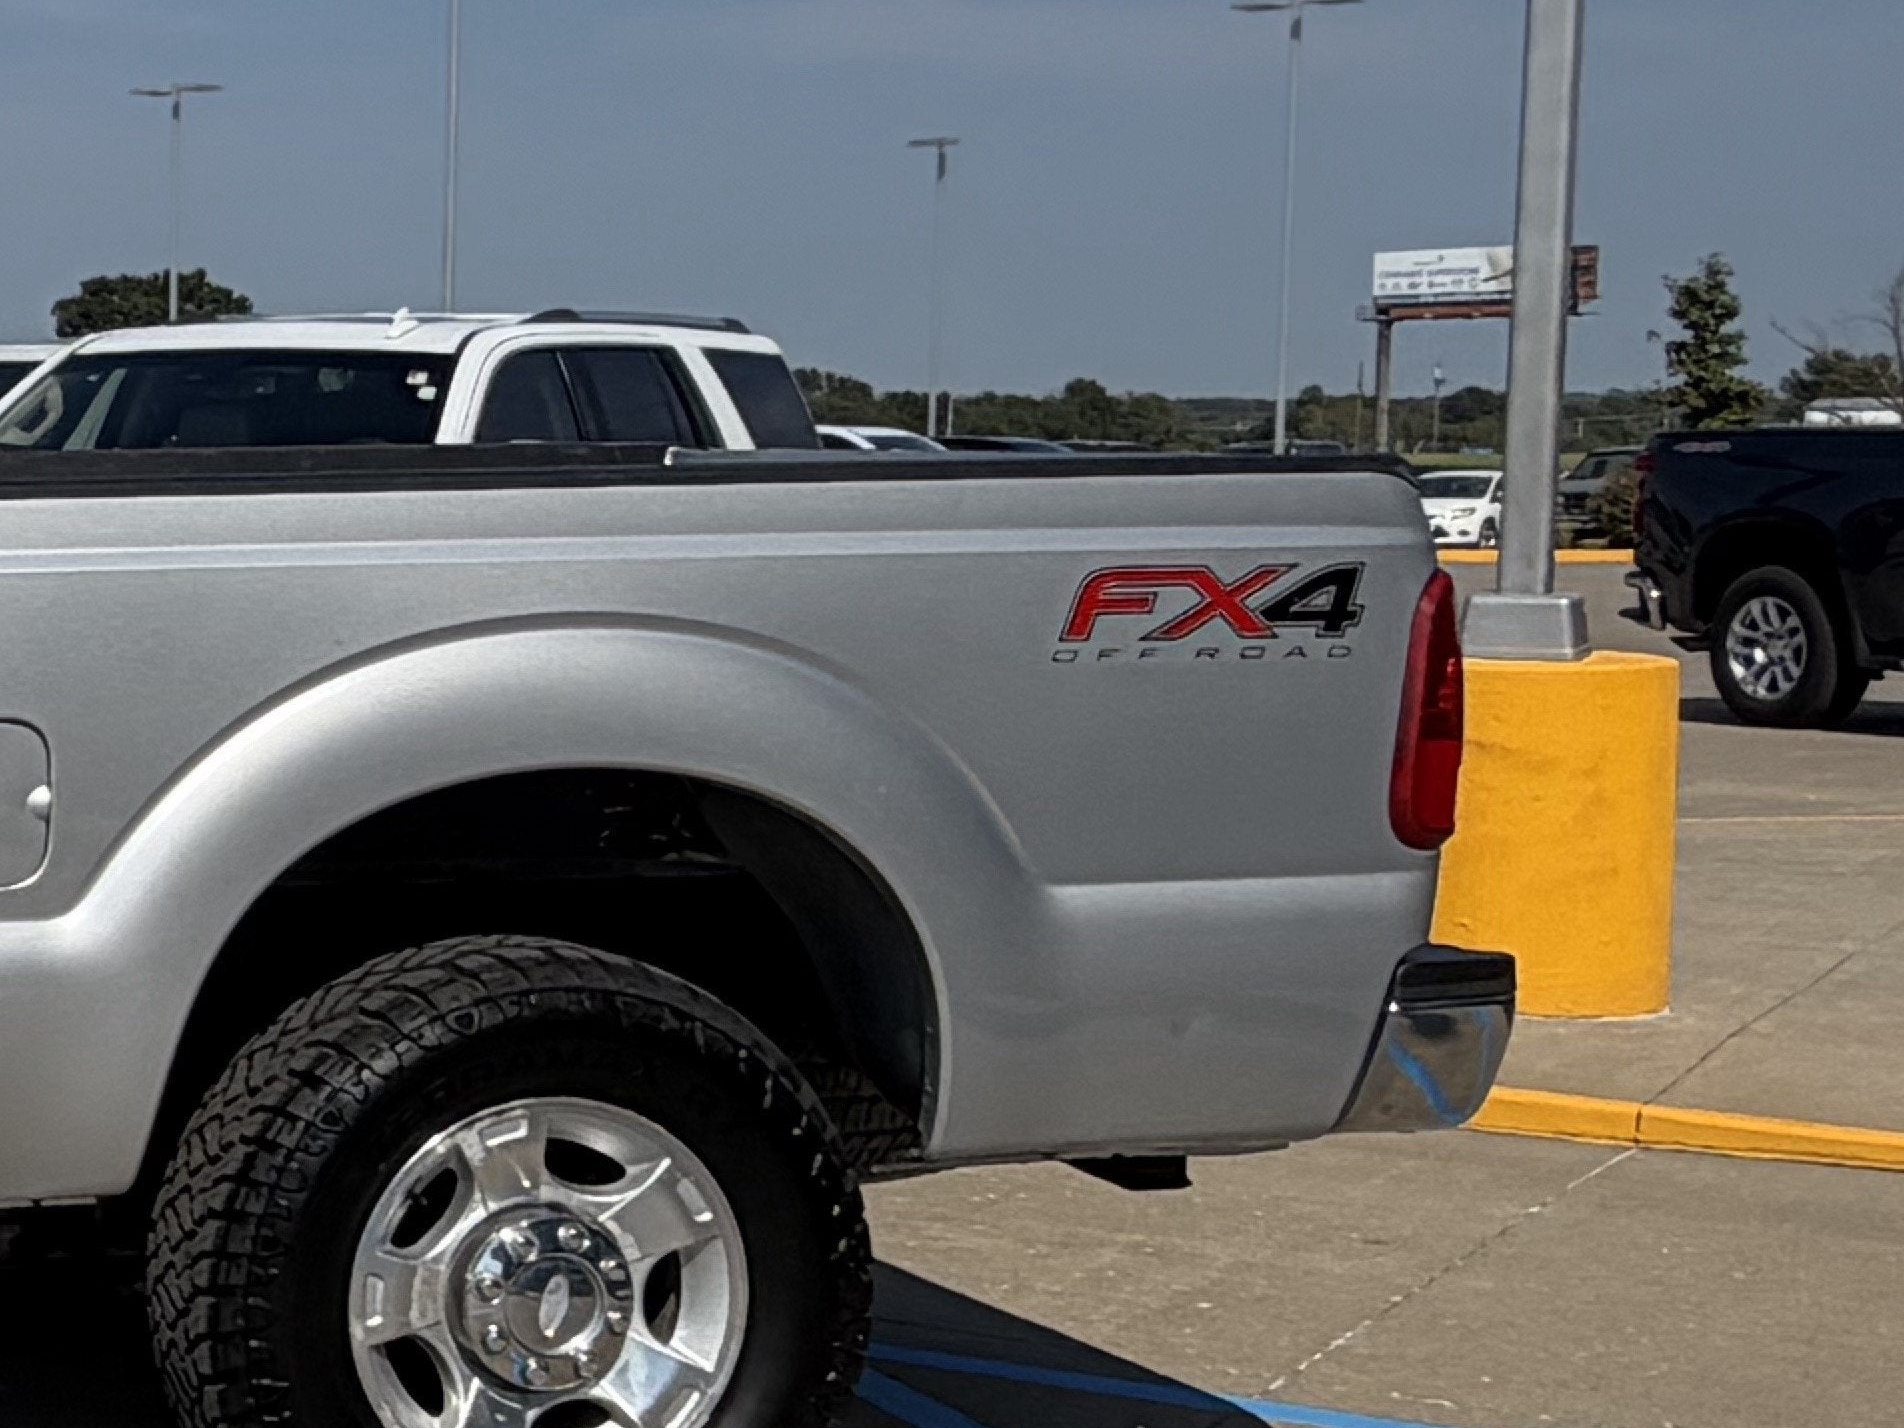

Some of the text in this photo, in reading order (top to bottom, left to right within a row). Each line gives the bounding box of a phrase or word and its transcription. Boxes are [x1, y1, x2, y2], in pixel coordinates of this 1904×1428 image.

[1059, 561, 1366, 641] FX4
[1050, 644, 1352, 663] OFF ROAD
